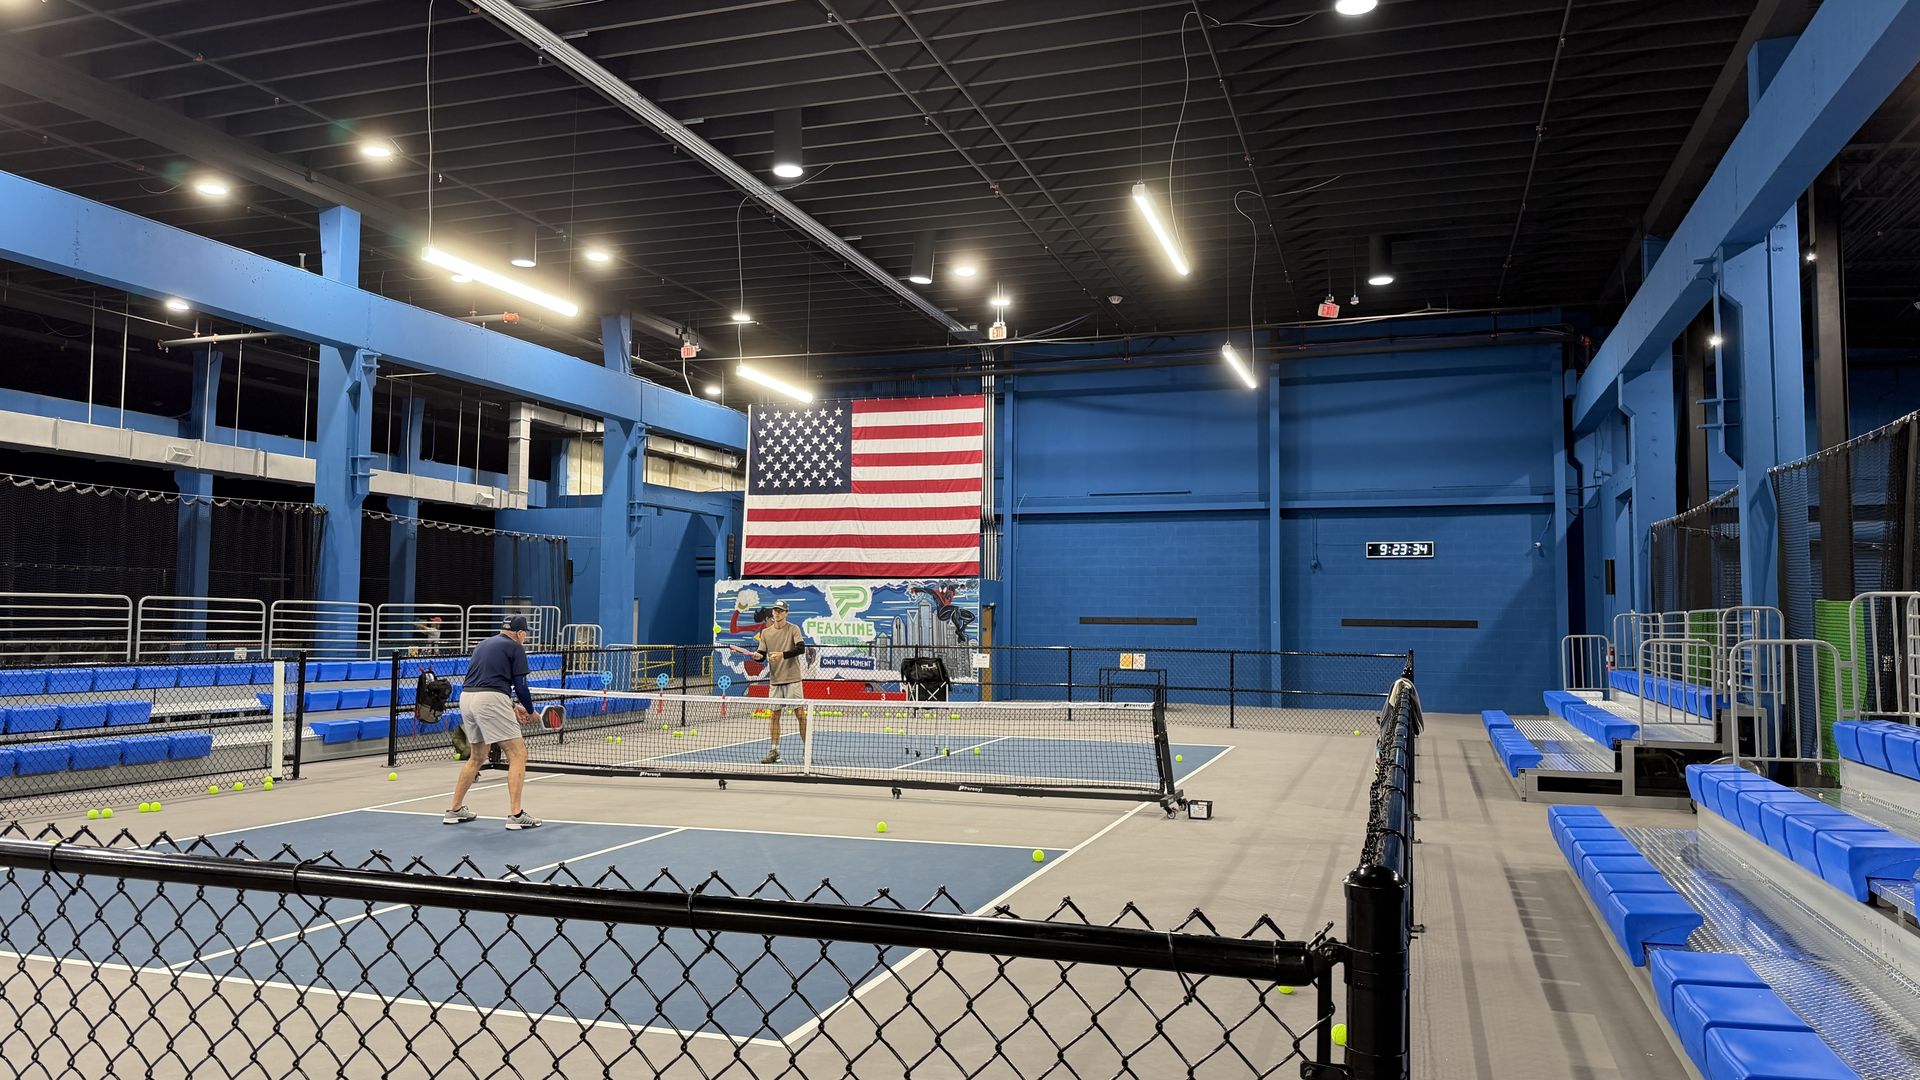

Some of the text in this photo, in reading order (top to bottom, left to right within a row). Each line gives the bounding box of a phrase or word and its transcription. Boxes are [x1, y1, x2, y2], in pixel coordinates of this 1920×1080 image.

[1380, 543, 1428, 556] 9:23:34
[806, 621, 874, 636] PEAKTIME
[850, 659, 871, 668] MOMENT
[826, 686, 831, 695] 1
